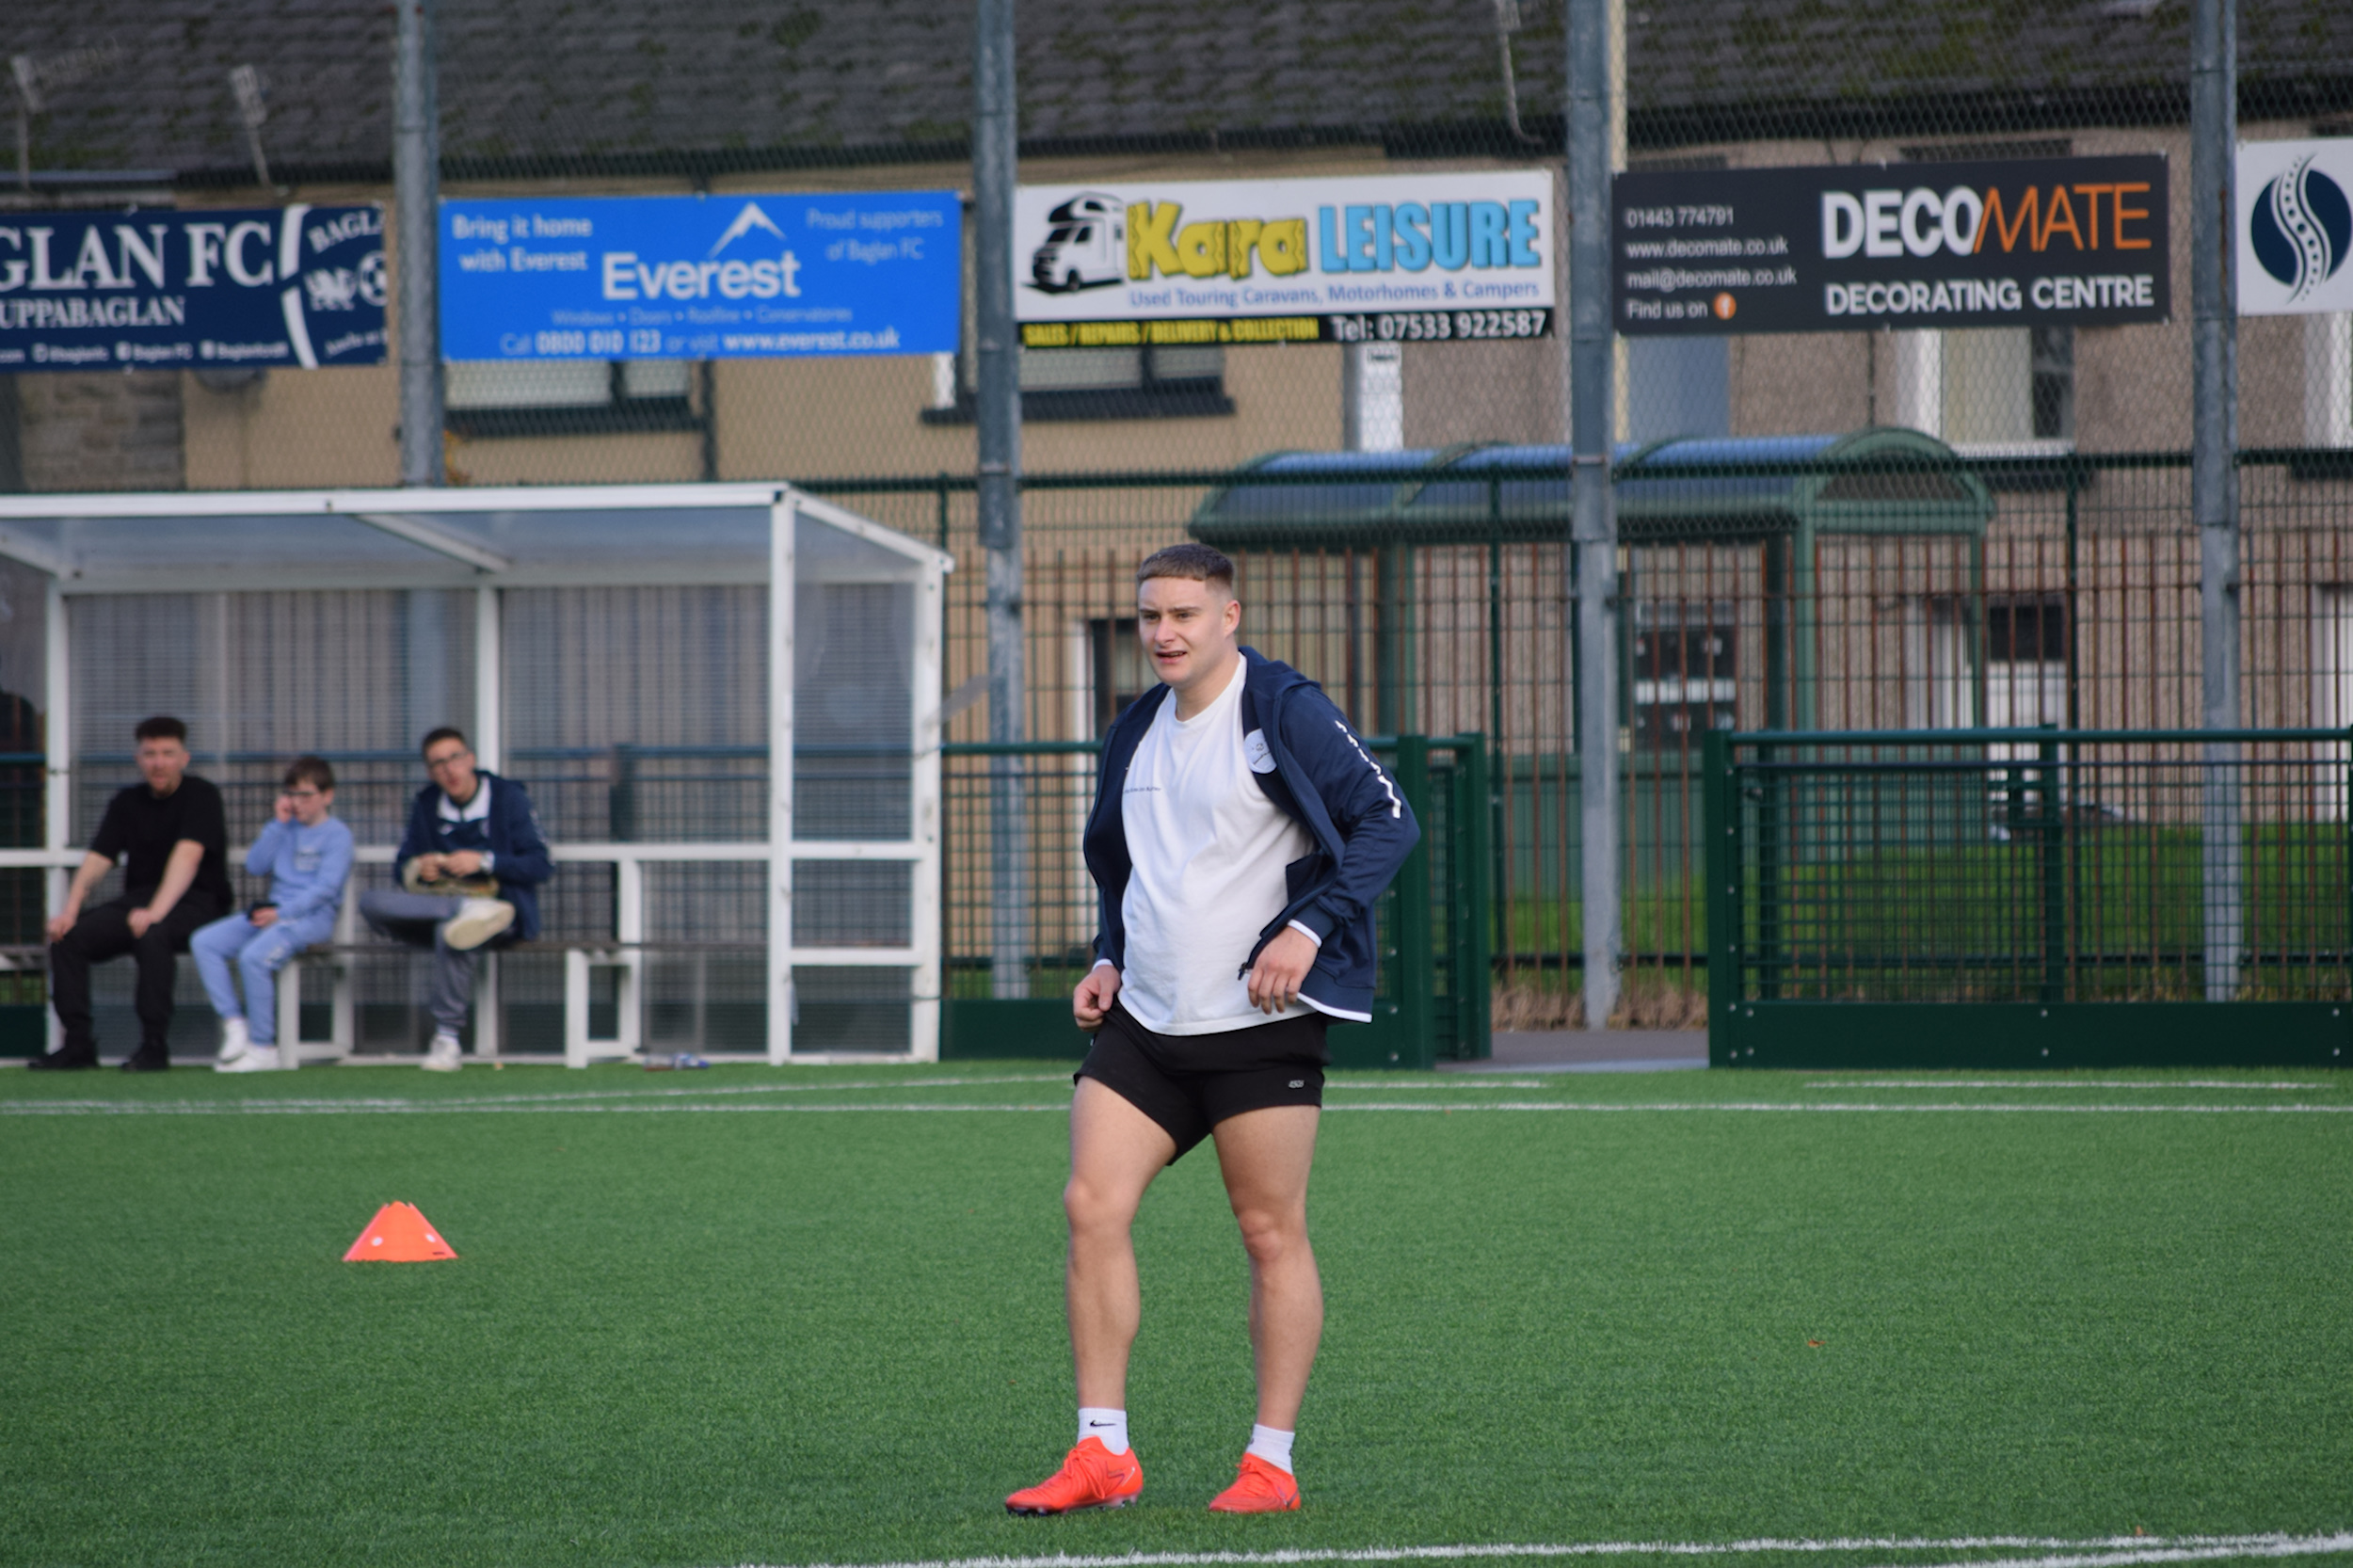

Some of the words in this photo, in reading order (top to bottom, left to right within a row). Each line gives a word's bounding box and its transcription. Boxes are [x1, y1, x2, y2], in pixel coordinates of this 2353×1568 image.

[452, 214, 508, 245] Bring
[511, 214, 529, 237] it
[533, 213, 593, 236] home
[806, 207, 856, 229] Proud
[860, 209, 943, 232] supporters
[1626, 206, 1674, 228] 01443
[1676, 204, 1734, 226] 774791
[184, 221, 273, 286] FC
[847, 238, 897, 265] Baglan
[900, 236, 924, 260] FC
[1127, 200, 1308, 280] Kara
[1319, 199, 1541, 273] LEISURE
[1626, 235, 1789, 258] www.decomate.co.uk
[458, 248, 506, 272] with
[510, 247, 588, 271] Everest
[602, 250, 801, 300] Everest
[1626, 265, 1797, 293] mail@decomate.co.uk
[1129, 290, 1171, 307] Used
[1176, 287, 1238, 309] Touring
[1242, 285, 1323, 307] Caravans,
[1328, 283, 1438, 303] Motorhomes
[1444, 280, 1456, 298] &
[1464, 280, 1540, 301] Campers
[1626, 297, 1662, 318] Find
[1665, 301, 1685, 318] us
[1687, 300, 1708, 318] on
[1825, 279, 2022, 315] DECORATING
[2030, 275, 2154, 310] CENTRE
[535, 330, 585, 355] 0800
[588, 330, 624, 354] 010
[629, 329, 661, 353] 123
[724, 326, 901, 351] www.everest.co.uk
[1023, 324, 1068, 345] SALES
[1079, 322, 1140, 344] REPAIRS
[1150, 320, 1217, 344] DELIVERY
[1231, 317, 1320, 341] COLLECTION
[1332, 315, 1374, 342] Tel:
[1377, 312, 1451, 341] 07533
[1456, 310, 1546, 338] 922587
